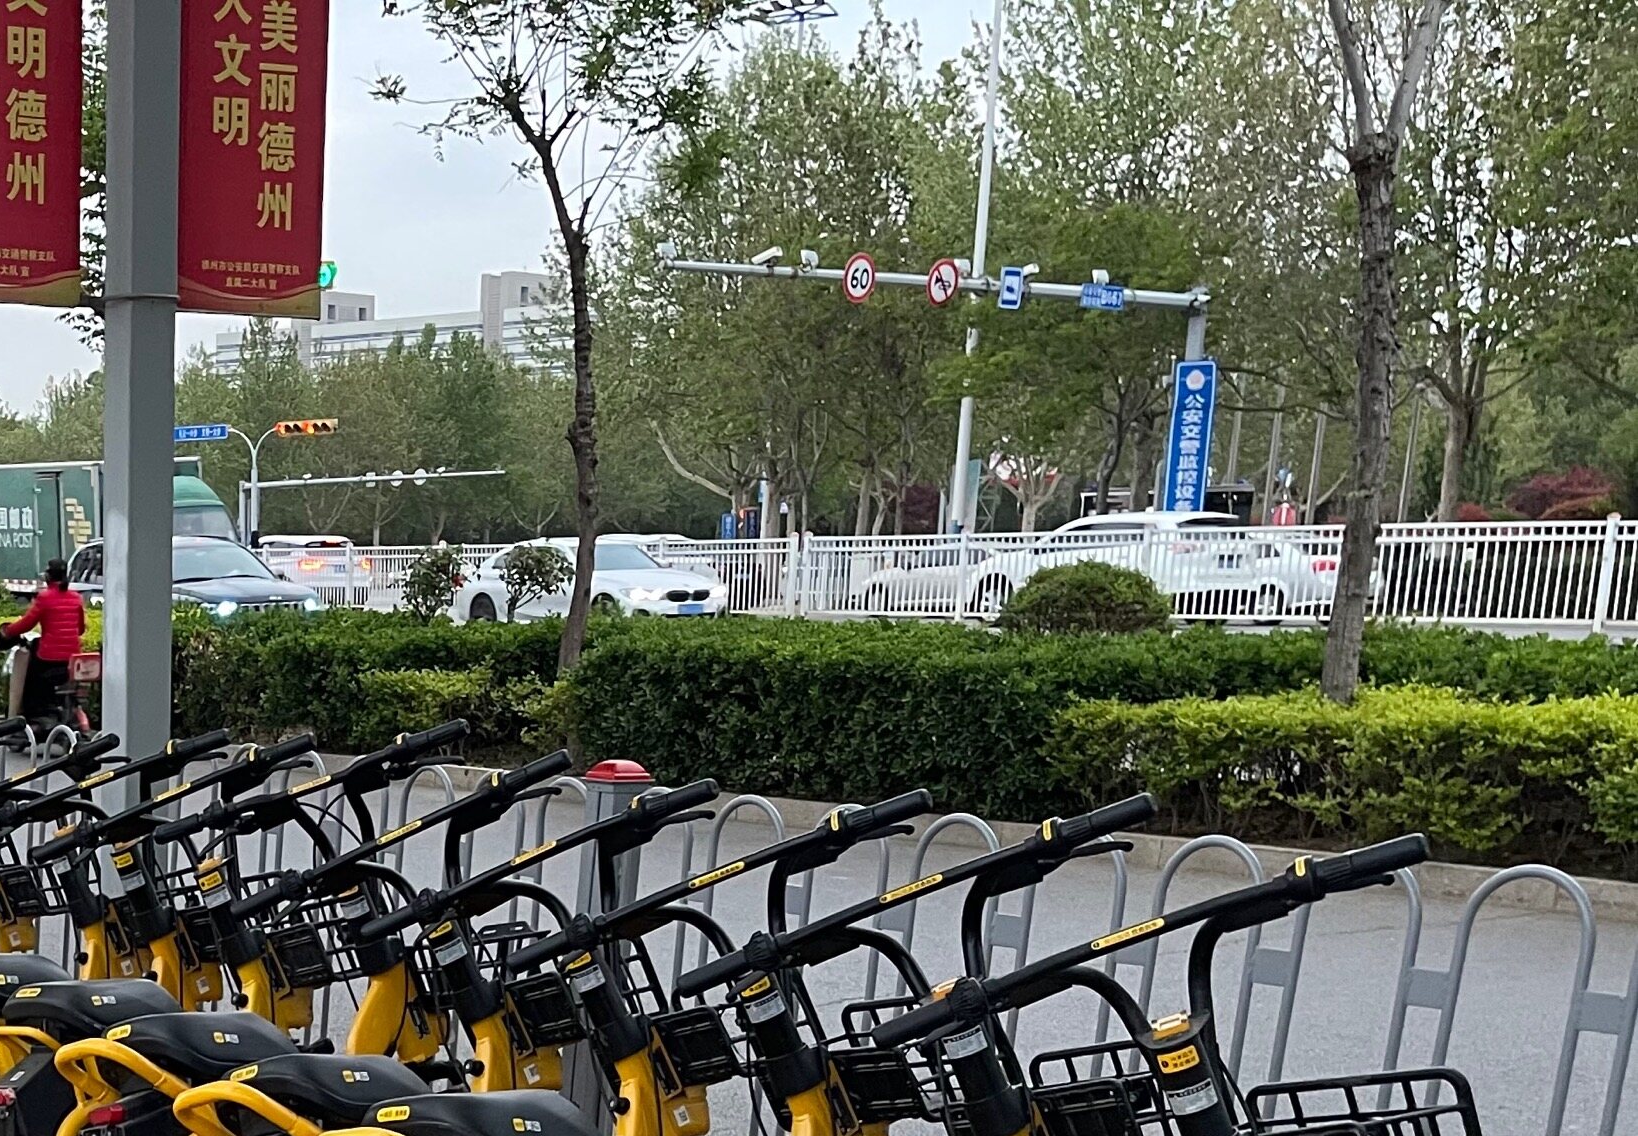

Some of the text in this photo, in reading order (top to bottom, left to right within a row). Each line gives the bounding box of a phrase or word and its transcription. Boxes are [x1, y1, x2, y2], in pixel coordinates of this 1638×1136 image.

[257, 0, 299, 231] 美丽德州
[850, 268, 870, 289] 60
[12, 532, 35, 549] POST
